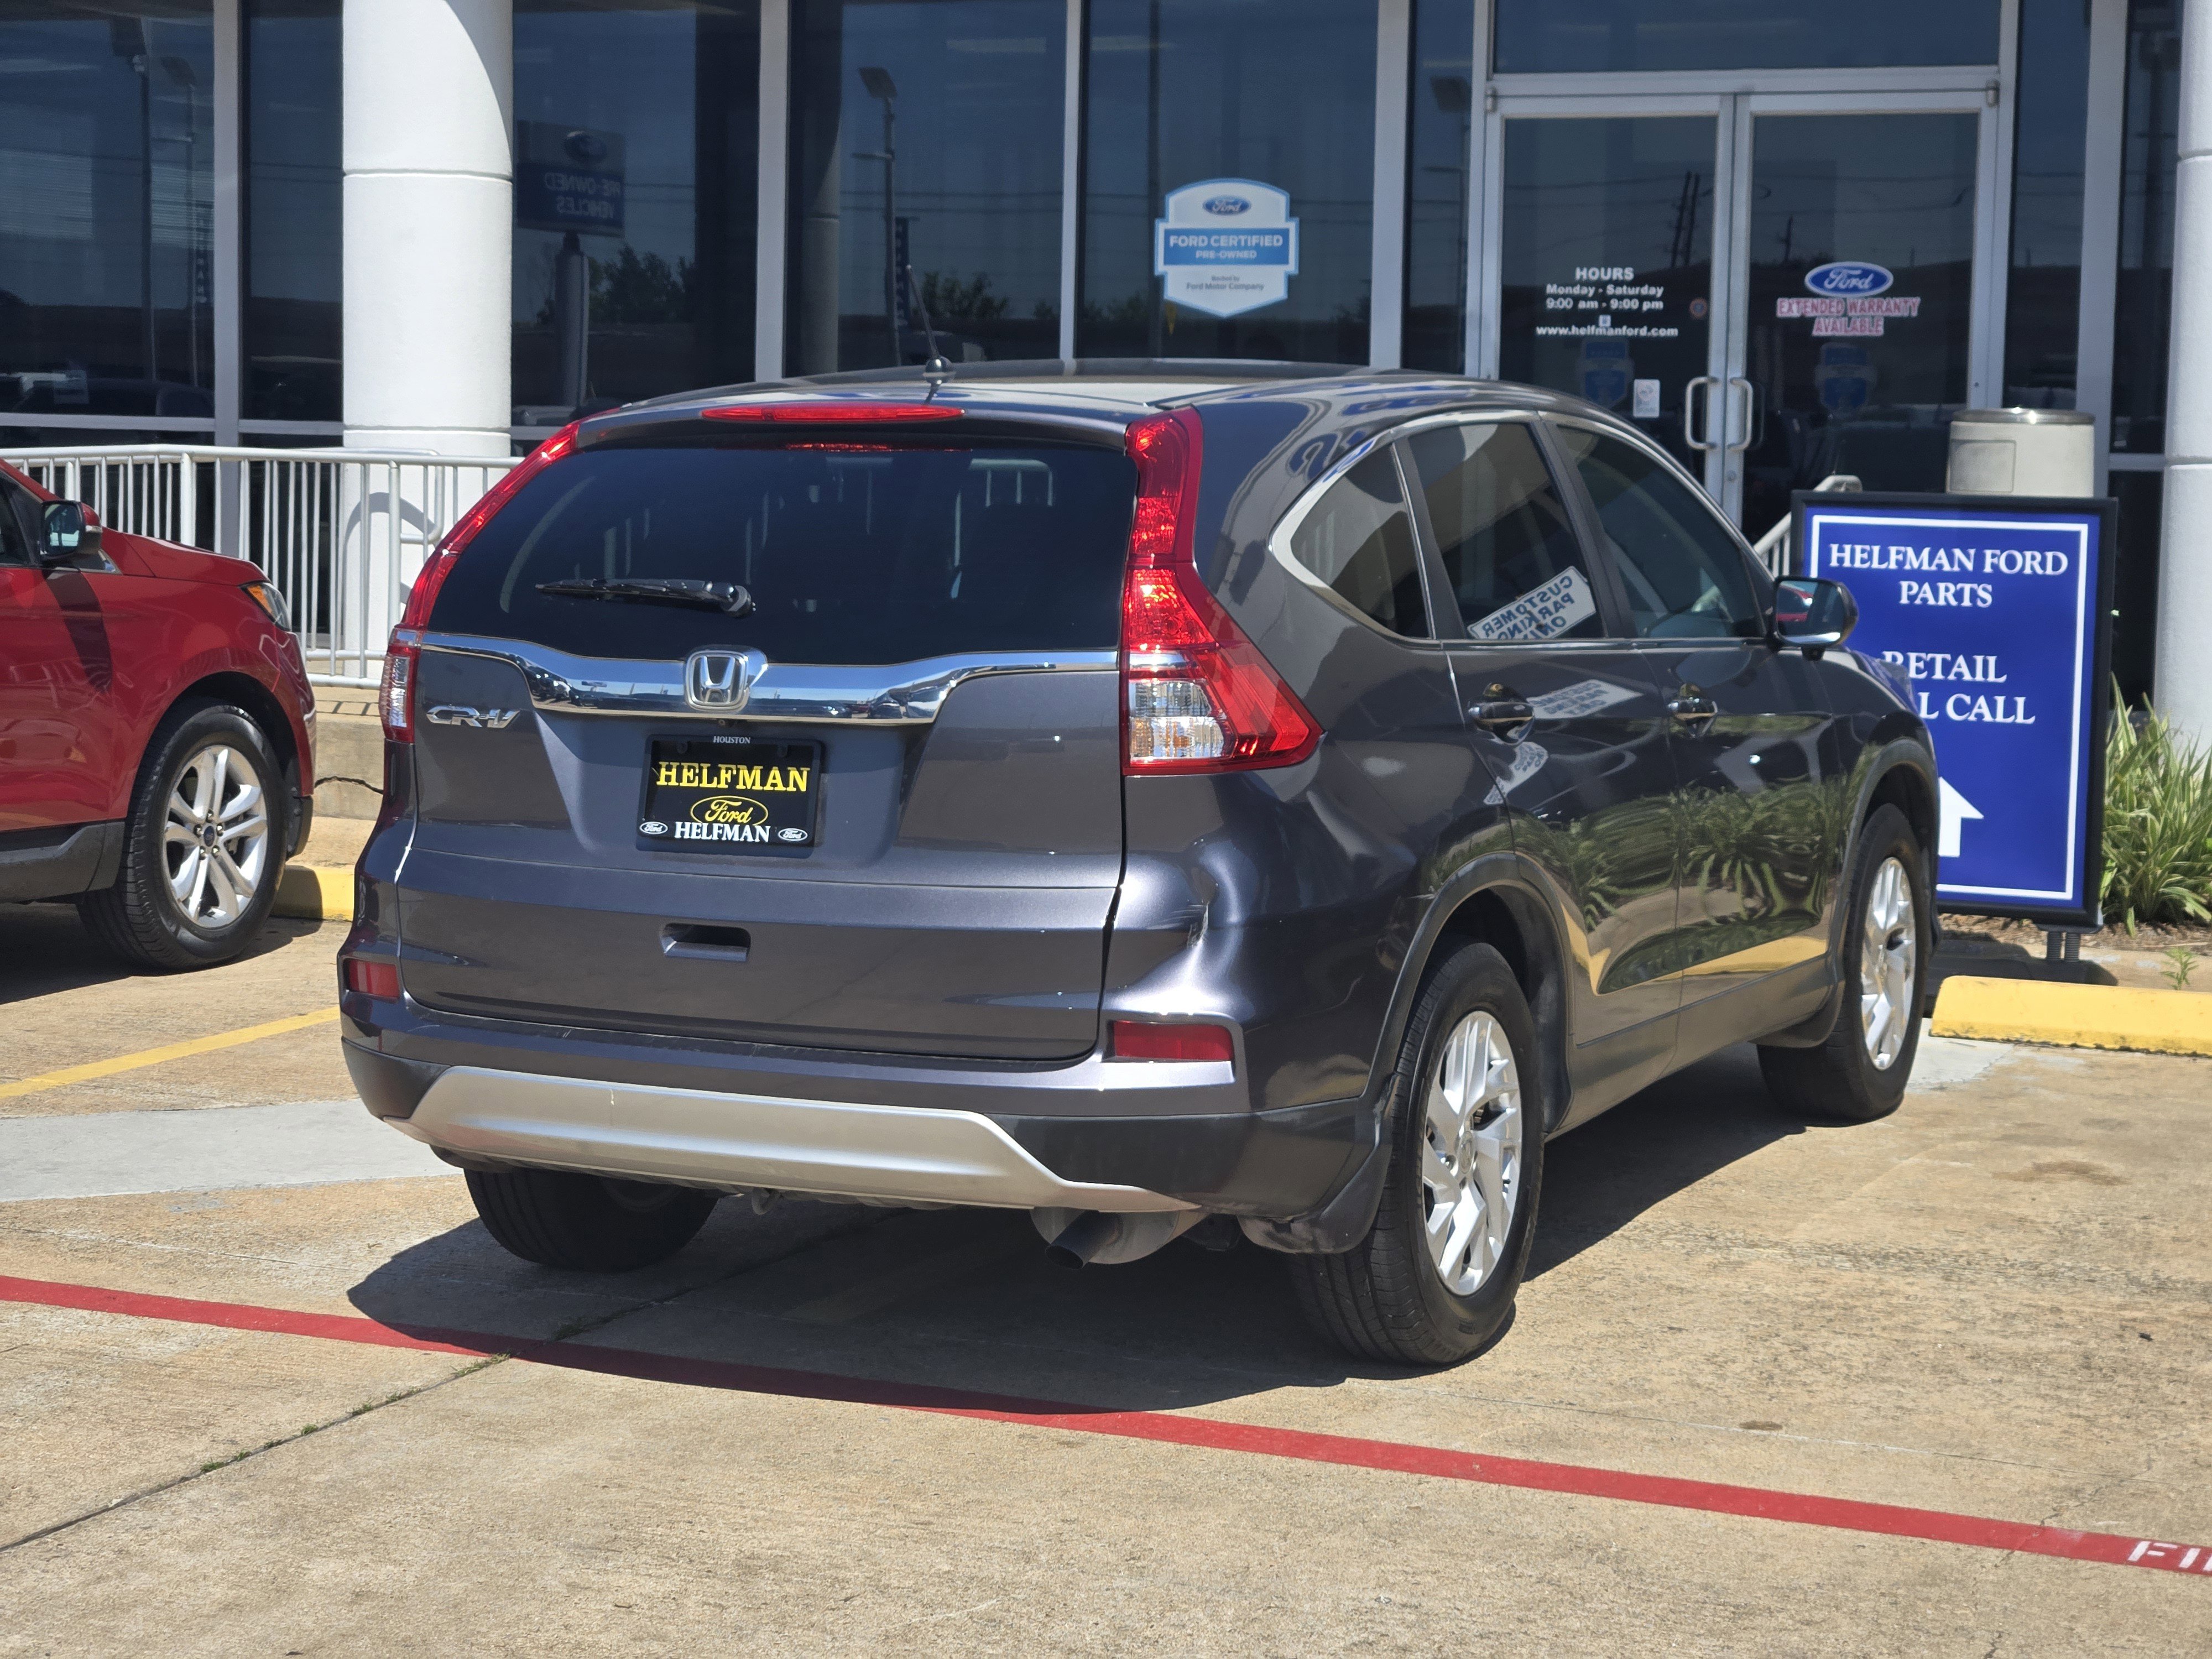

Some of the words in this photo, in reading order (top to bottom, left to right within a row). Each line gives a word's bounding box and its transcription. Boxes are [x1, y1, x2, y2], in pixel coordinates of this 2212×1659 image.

[1212, 200, 1241, 213] Ford
[1169, 235, 1208, 248] FORD
[1210, 235, 1283, 247] CERTIFIED
[1195, 250, 1257, 259] PRE-OWNED
[1575, 267, 1634, 281] HOURS
[1824, 268, 1875, 289] Ford
[1186, 282, 1203, 290] Ford
[1229, 283, 1265, 291] Company
[1546, 284, 1595, 297] Monday
[1606, 284, 1664, 297] Saturday
[1546, 298, 1573, 310] 9:00
[1577, 300, 1599, 310] am
[1610, 298, 1639, 310] 9:00
[1642, 300, 1663, 312] pm
[1776, 298, 1845, 317] EXTENDED
[1846, 297, 1921, 317] WARRANTY
[1536, 325, 1678, 337] www.helfmanford.com
[1812, 317, 1884, 336] AVAILABLE
[1829, 544, 1976, 572] HELFMAN
[1983, 549, 2068, 576] FORD
[1898, 580, 1992, 608] PARTS
[426, 705, 520, 728] CR-V
[1946, 694, 2036, 724] CALL
[713, 735, 752, 744] HOUSTON
[656, 761, 811, 792] HELFMAN
[705, 800, 753, 823] Ford
[674, 821, 771, 843] HELFMAN
[2128, 1541, 2212, 1572] FI
